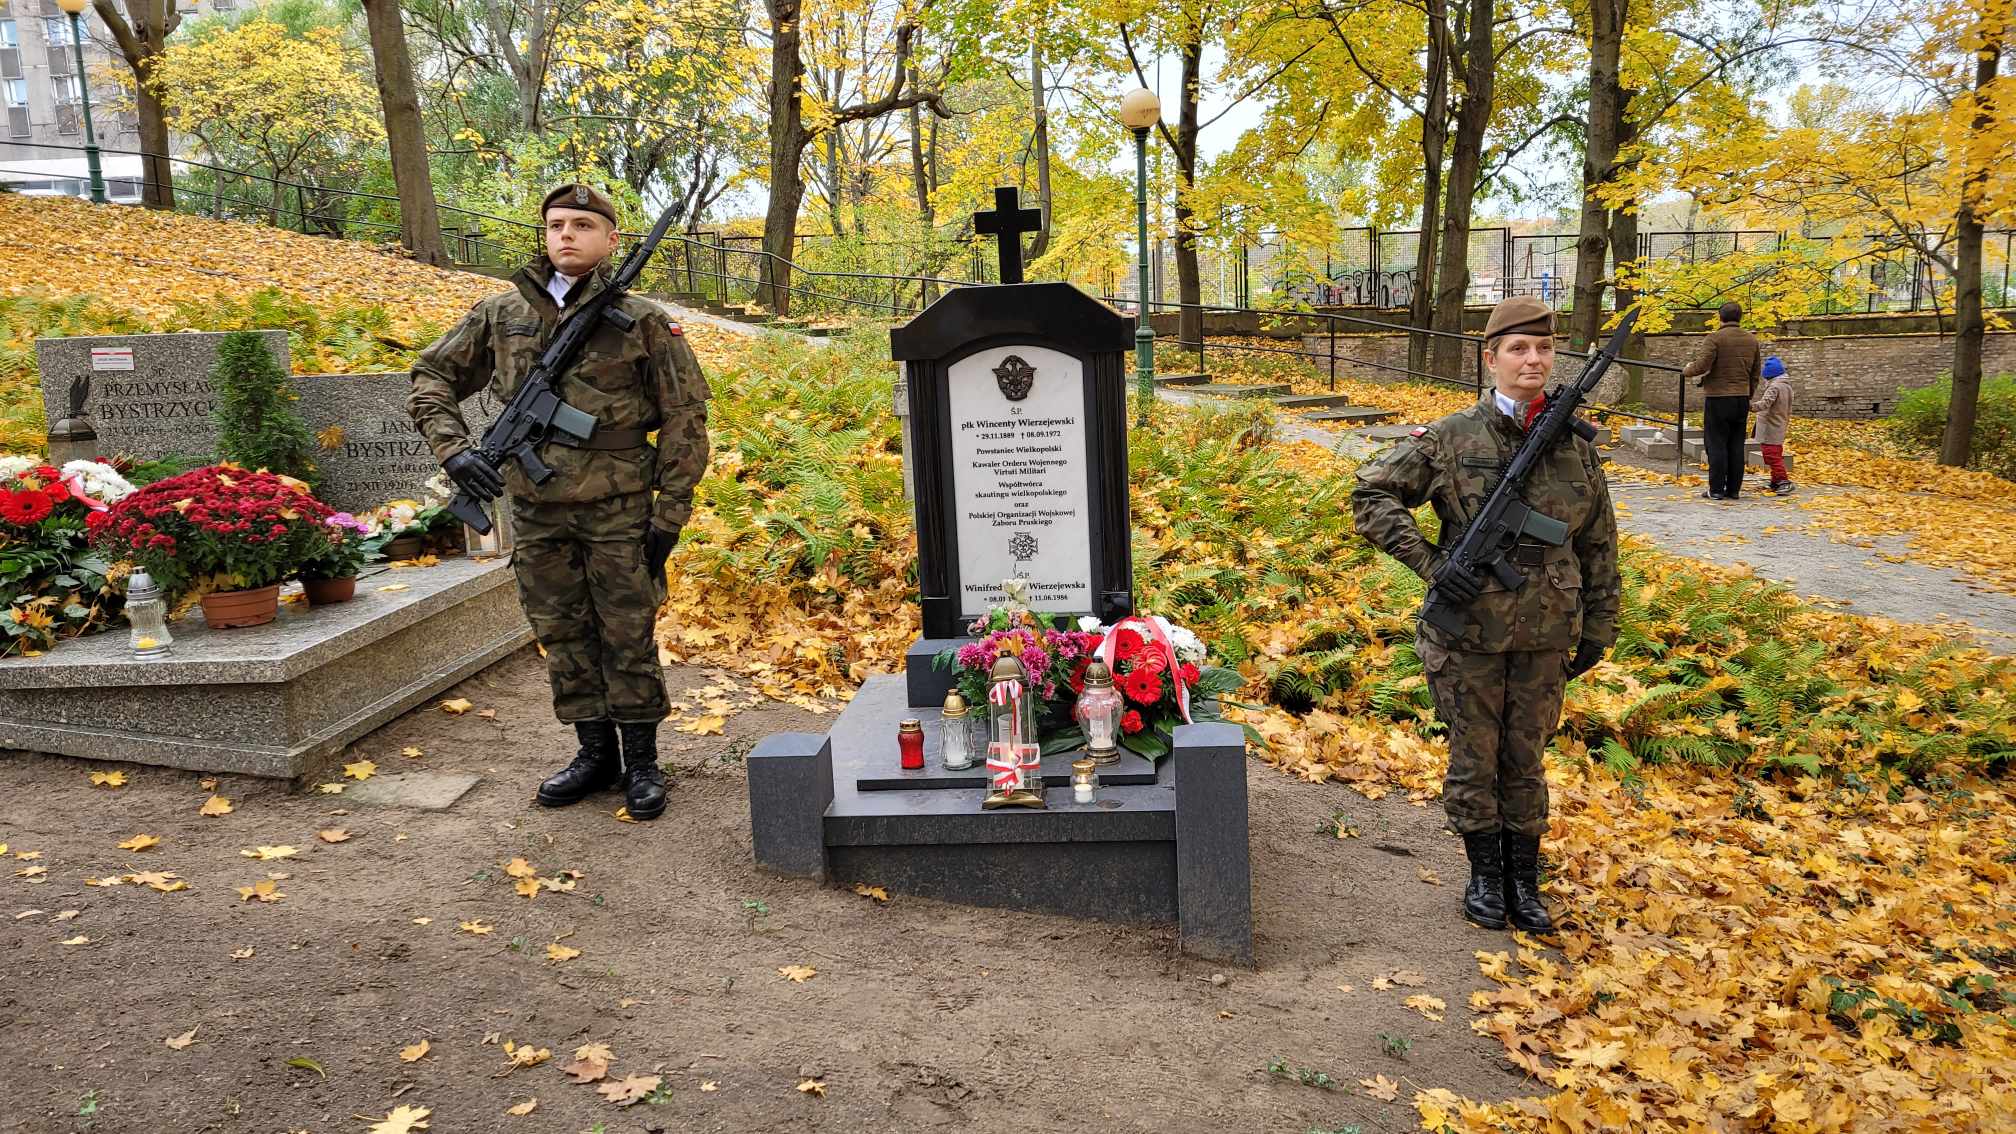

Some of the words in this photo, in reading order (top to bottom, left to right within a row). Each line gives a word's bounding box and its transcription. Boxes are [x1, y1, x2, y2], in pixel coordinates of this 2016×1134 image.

[961, 421, 975, 431] płk
[977, 419, 1016, 429] Wincenty
[1018, 417, 1075, 428] Wierzejewski
[1026, 430, 1061, 438] 08.09.1972
[345, 440, 434, 458] BYSTRZY
[1016, 446, 1062, 455] Wielkopolski
[972, 461, 1001, 469] Kawaler
[1029, 459, 1068, 467] Wojennego
[993, 468, 1018, 476] Virtuti
[1019, 467, 1046, 475] Militari
[998, 481, 1043, 490] Współtwórca
[975, 491, 1010, 499] skautingu
[1011, 489, 1068, 499] wielkopolskiego
[968, 511, 996, 520] Polskiej
[997, 511, 1037, 520] Organizacji
[1038, 509, 1076, 518] Wojskowej
[1018, 519, 1053, 527] Pruskiego
[965, 583, 1003, 593] Winifred
[1029, 581, 1086, 592] Wierzejewska
